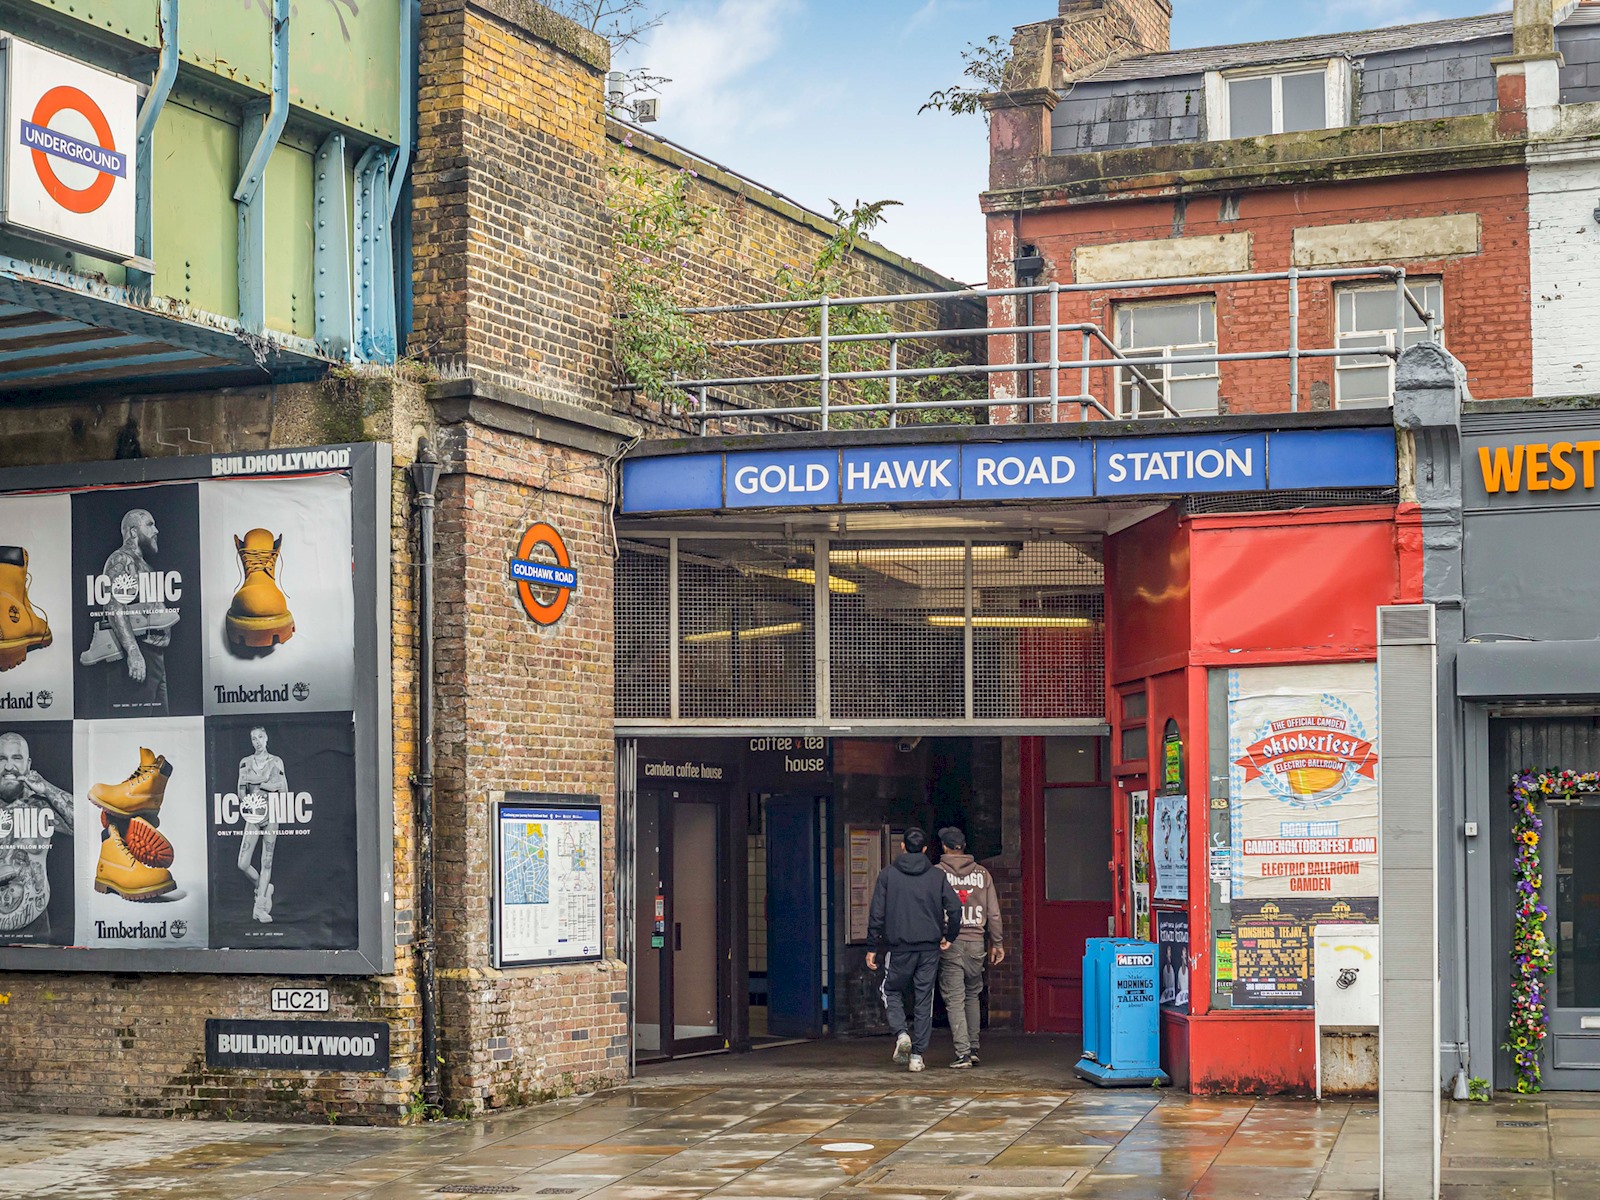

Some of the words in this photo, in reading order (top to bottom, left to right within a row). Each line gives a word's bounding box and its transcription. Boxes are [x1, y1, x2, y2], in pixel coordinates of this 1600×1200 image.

[25, 126, 121, 172] UNDERGROUND
[211, 448, 351, 476] BUILDHOLLYWOOD
[1478, 440, 1600, 494] WEST
[734, 463, 830, 495] GOLD
[847, 459, 953, 490] HAWK
[977, 455, 1076, 486] ROAD
[1108, 447, 1252, 483] STATION
[513, 563, 554, 581] GOLDHAWK
[555, 572, 574, 583] ROAD
[0, 691, 33, 709] rland
[214, 683, 289, 704] Timberland
[1272, 721, 1286, 732] THE
[1286, 718, 1316, 728] OFFICIAL
[1317, 717, 1345, 730] CAMDEN
[1262, 733, 1359, 758] oktoberfest
[645, 761, 675, 777] camden
[676, 762, 700, 778] coffee
[700, 763, 723, 779] house
[785, 755, 824, 772] house
[1275, 760, 1306, 773] ELECTRIC
[1308, 759, 1344, 771] BALLROOM
[1281, 823, 1308, 837] BOOK
[1310, 822, 1338, 836] NOW!
[1244, 838, 1375, 854] CAMDENOKTOBERFEST.COM
[1261, 862, 1305, 876] ELECTRIC
[1307, 861, 1359, 875] BALLROOM
[946, 872, 984, 889] HICAGO
[1290, 878, 1331, 892] CAMDEN
[94, 920, 167, 939] Timberland
[1279, 926, 1302, 938] TEEJAY
[1118, 955, 1152, 966] METRO
[1117, 979, 1154, 989] MORNINGS
[276, 991, 324, 1009] HC21
[1117, 994, 1154, 1003] TALKING
[218, 1033, 377, 1057] BUILDHOLLYWOOD
